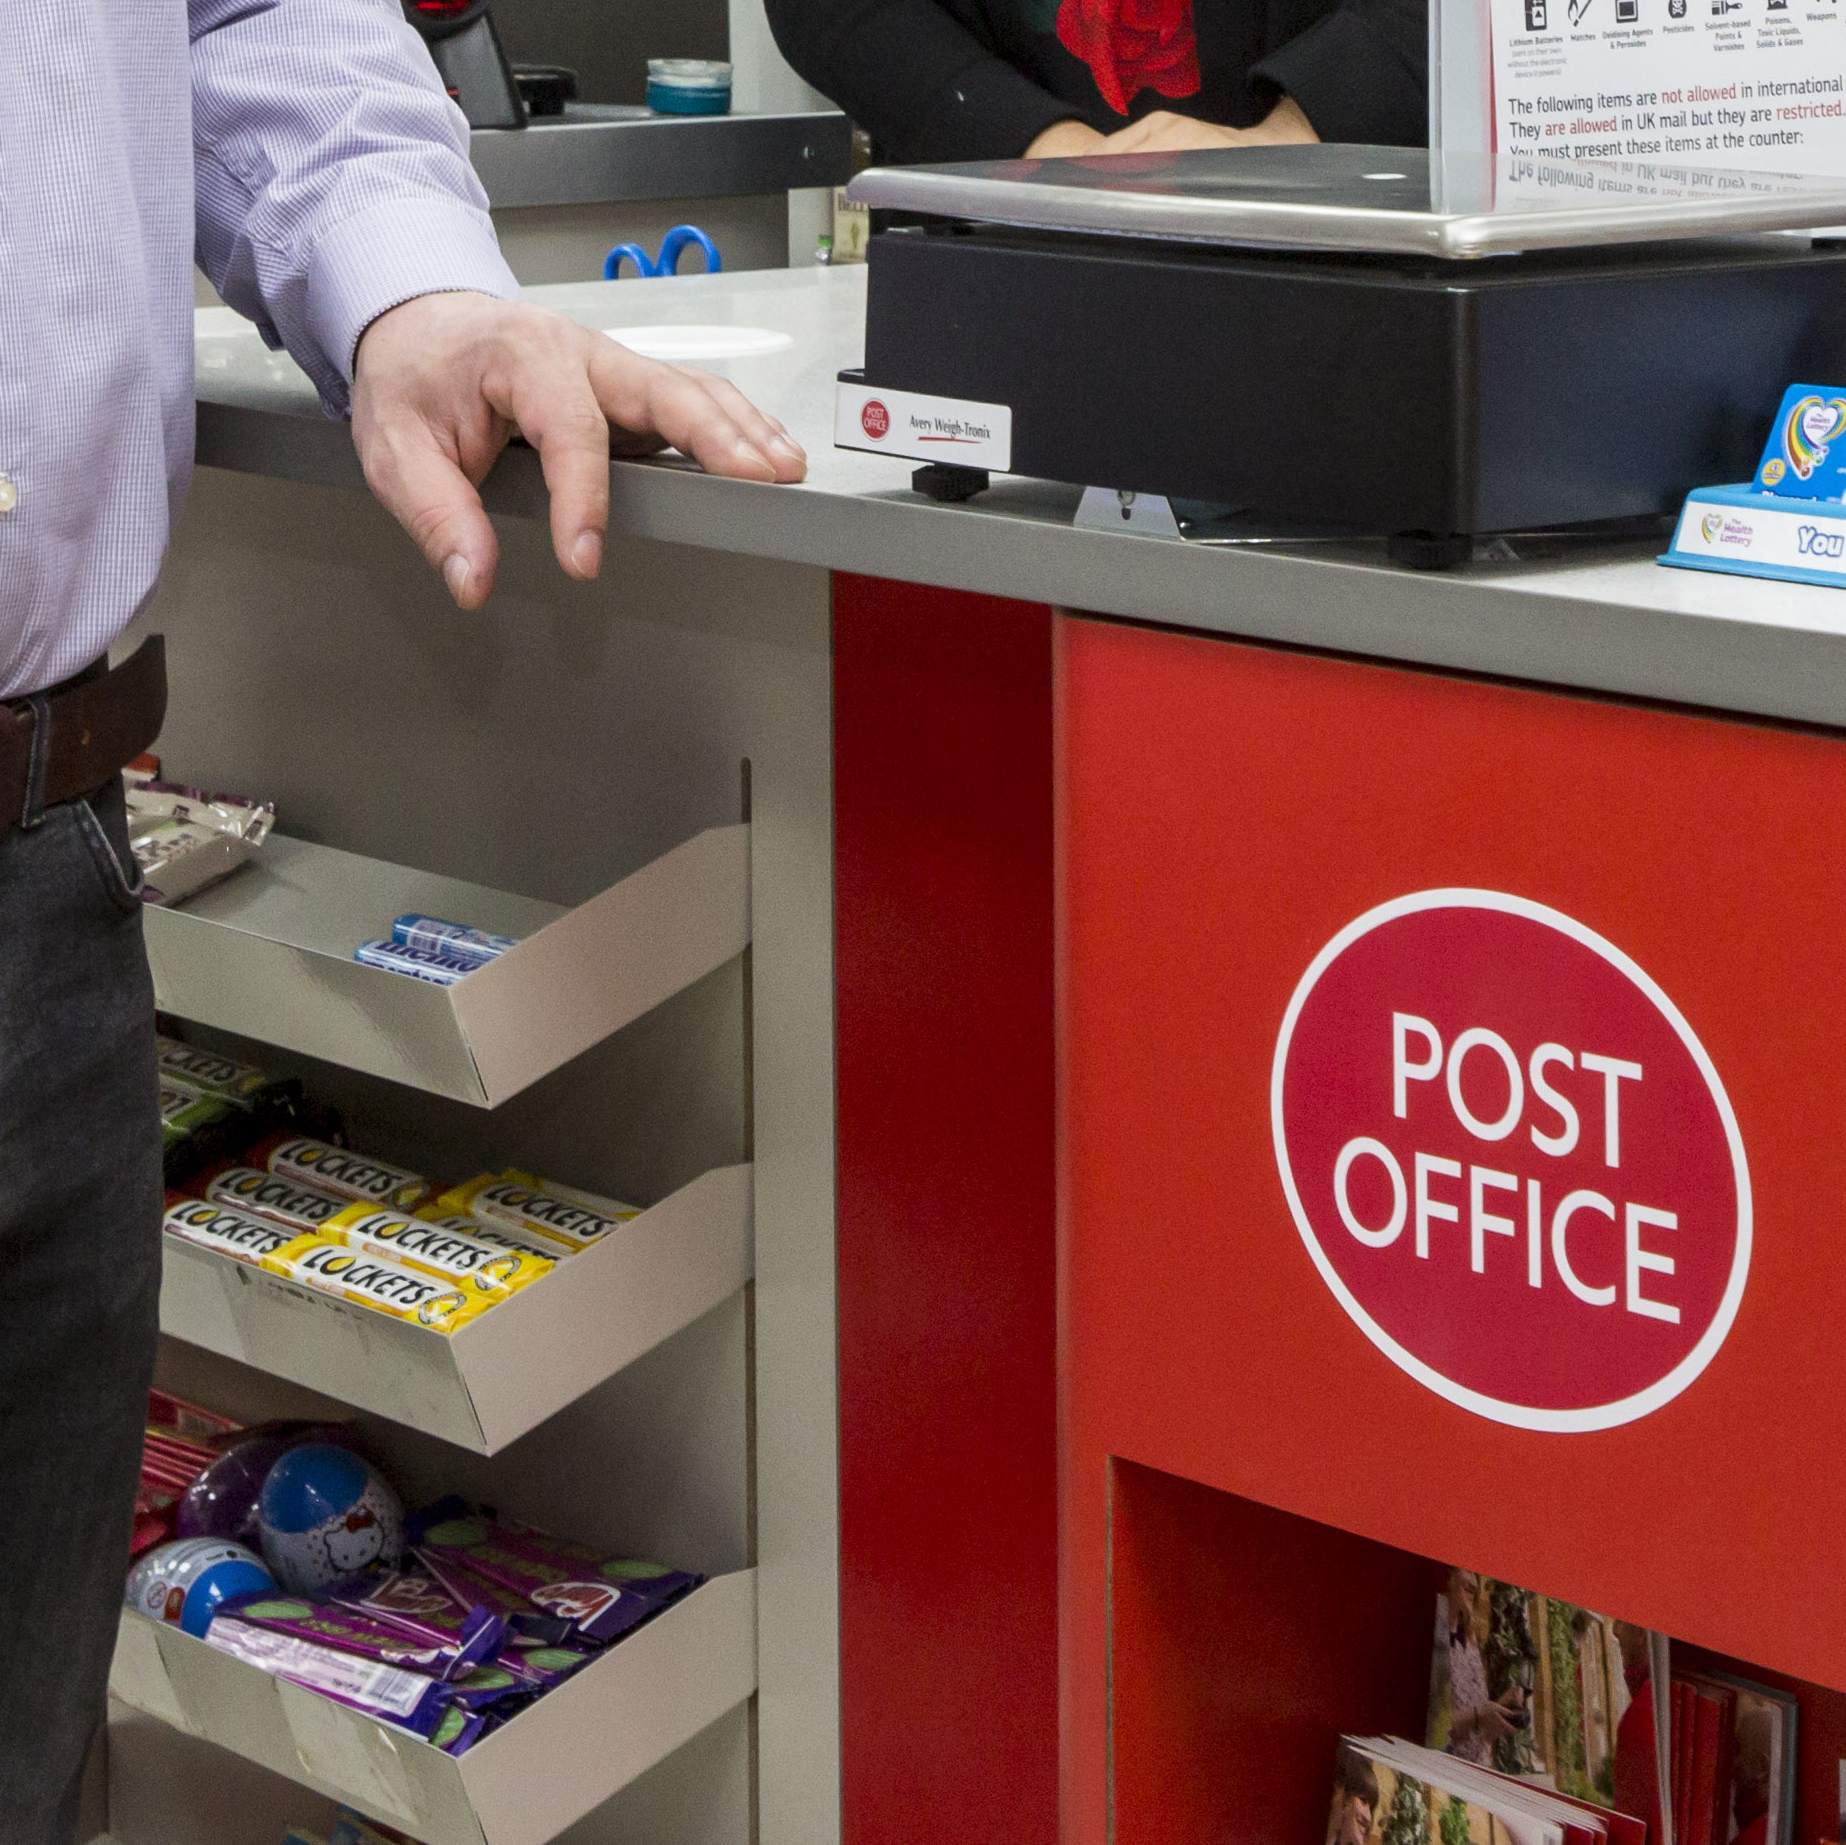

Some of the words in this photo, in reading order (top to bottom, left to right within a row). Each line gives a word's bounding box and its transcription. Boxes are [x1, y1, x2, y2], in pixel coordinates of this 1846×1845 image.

[1509, 98, 1533, 115] The
[1537, 94, 1592, 114] following
[1597, 90, 1632, 108] items
[1637, 90, 1657, 105] are
[1662, 86, 1683, 103] not
[1687, 84, 1736, 103] allowed
[1741, 83, 1752, 98] in
[1757, 74, 1842, 96] international
[1510, 122, 1541, 141] They
[1545, 121, 1565, 136] are
[1569, 116, 1617, 134] allowed
[1621, 115, 1632, 130] in
[1637, 113, 1655, 129] UK
[1660, 109, 1687, 128] mail
[1691, 108, 1713, 125] but
[1717, 108, 1746, 127] they
[1751, 108, 1772, 122] are
[1777, 101, 1845, 120] restricted.
[1510, 142, 1533, 156] You
[1537, 140, 1570, 158] must
[1575, 136, 1622, 159] present
[1627, 138, 1660, 154] these
[1665, 134, 1701, 151] items
[1706, 134, 1719, 149] at
[1724, 131, 1745, 147] the
[1749, 129, 1803, 146] counter:
[866, 408, 884, 421] POST
[910, 415, 931, 434] Avery
[935, 418, 990, 440] Weigh-Tronix
[1720, 532, 1752, 548] Lottery
[1724, 522, 1753, 536] Health
[1798, 526, 1844, 557] You
[1392, 1012, 1643, 1168] POST
[357, 1215, 489, 1270] LOCKETS
[1334, 1136, 1680, 1324] OFFICE
[305, 1247, 431, 1303] LOCKETS
